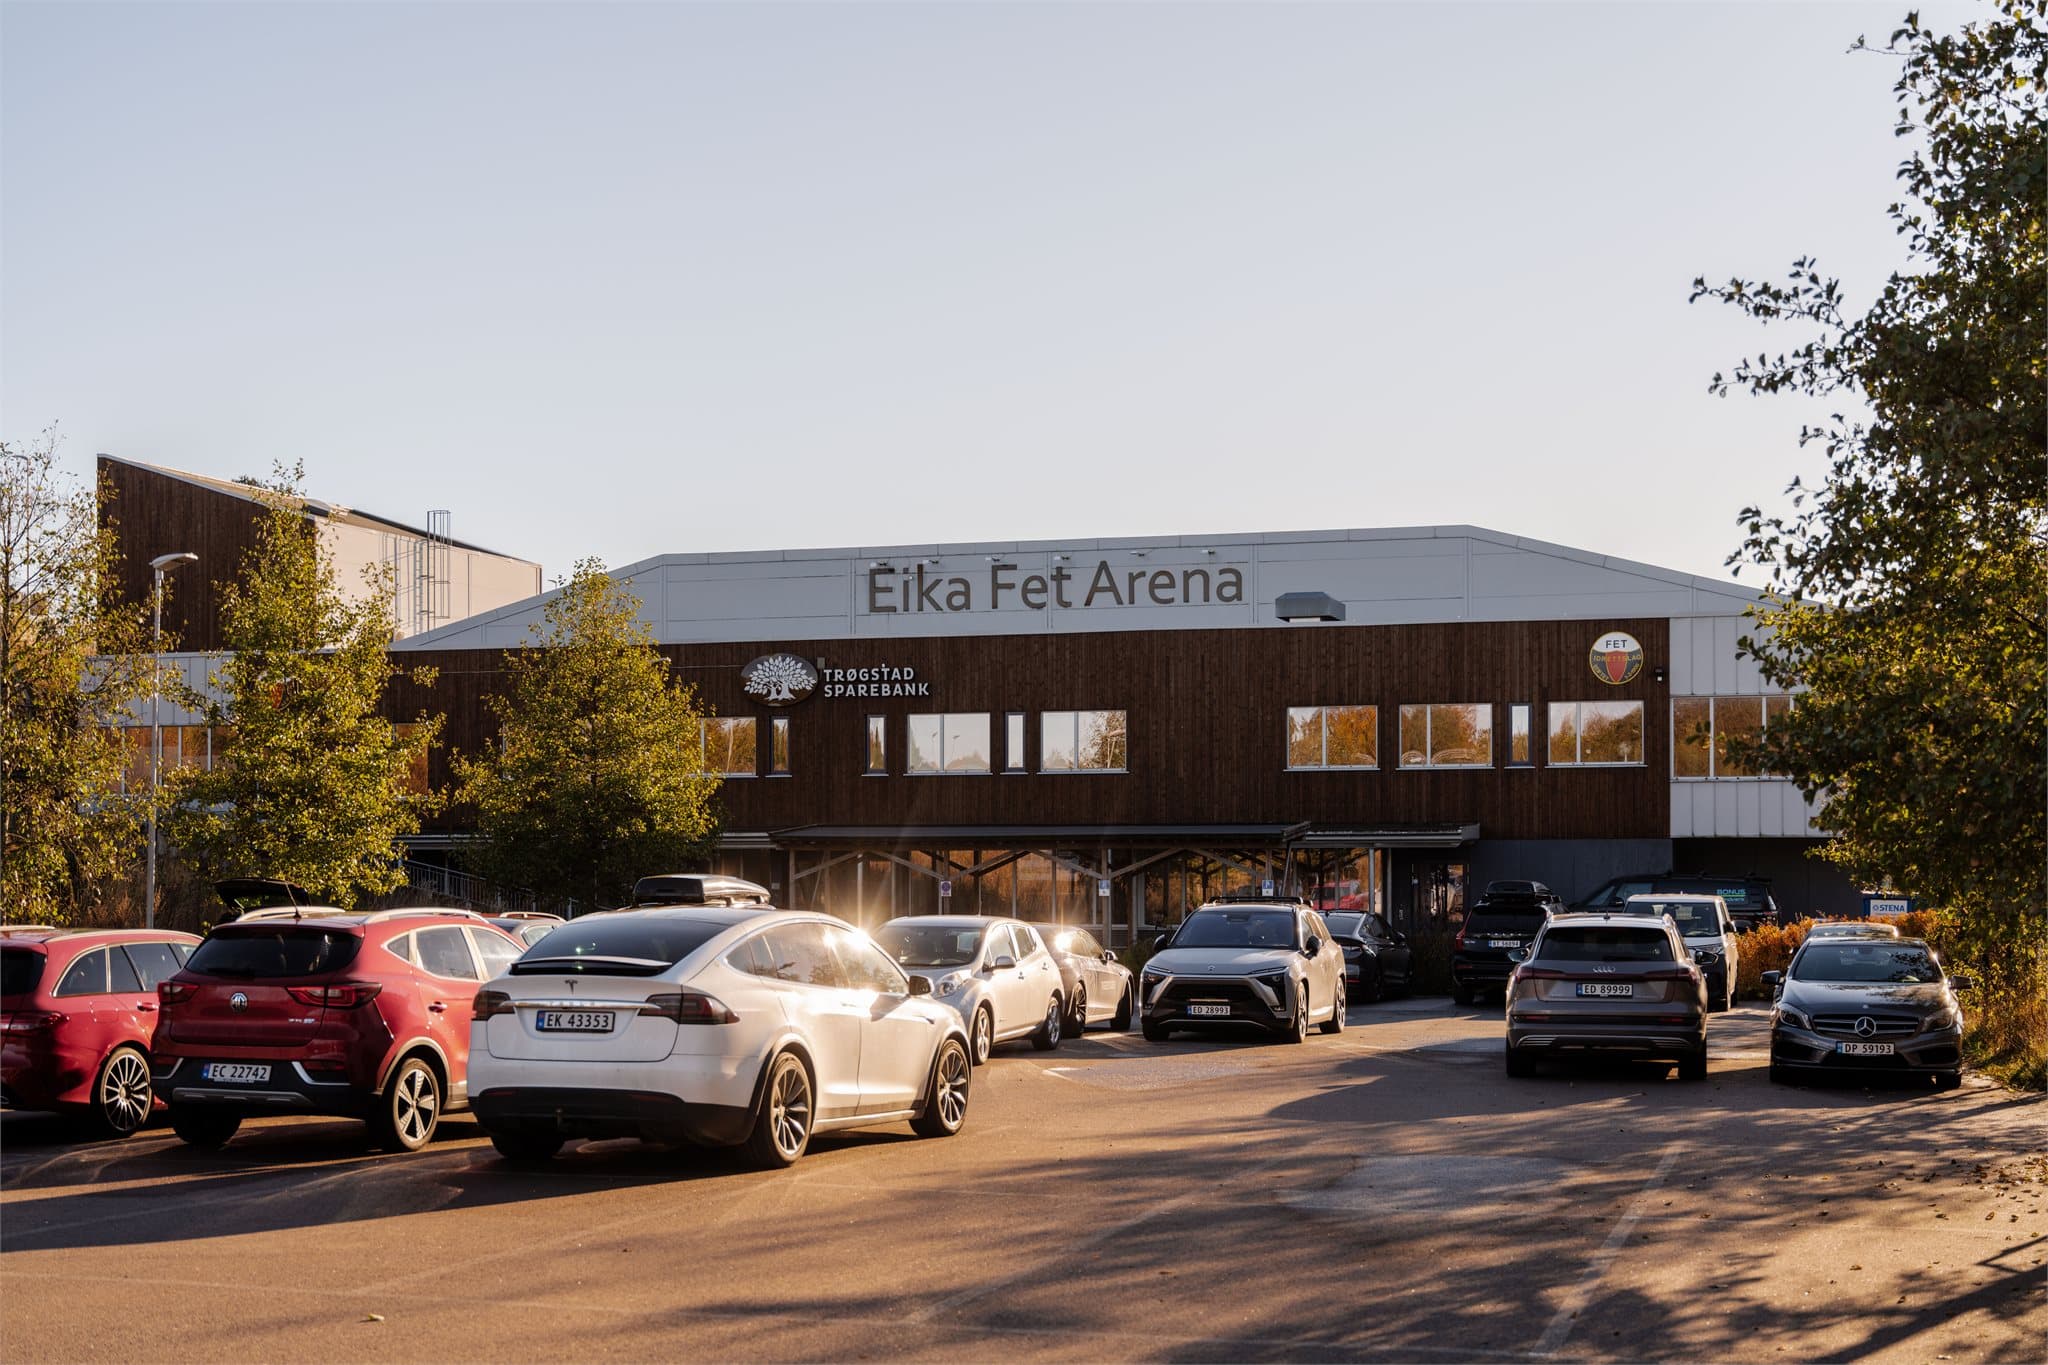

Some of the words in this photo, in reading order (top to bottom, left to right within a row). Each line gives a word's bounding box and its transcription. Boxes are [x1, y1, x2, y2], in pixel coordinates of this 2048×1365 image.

[868, 563, 971, 613] Eika
[991, 563, 1072, 609] Fet
[1084, 560, 1243, 607] Arena
[1605, 639, 1628, 649] FET
[823, 666, 915, 682] TRØGSTAD
[823, 682, 930, 698] SPAREBANK
[1879, 904, 1905, 912] STENA
[1584, 984, 1597, 994] ED
[1600, 984, 1631, 994] 89999
[1192, 1006, 1203, 1014] ED
[546, 1013, 563, 1027] EK
[567, 1014, 609, 1028] 43353
[1844, 1043, 1858, 1053] DP
[1862, 1044, 1892, 1054] 59193
[211, 1064, 227, 1078] EC
[230, 1065, 267, 1080] 22742
